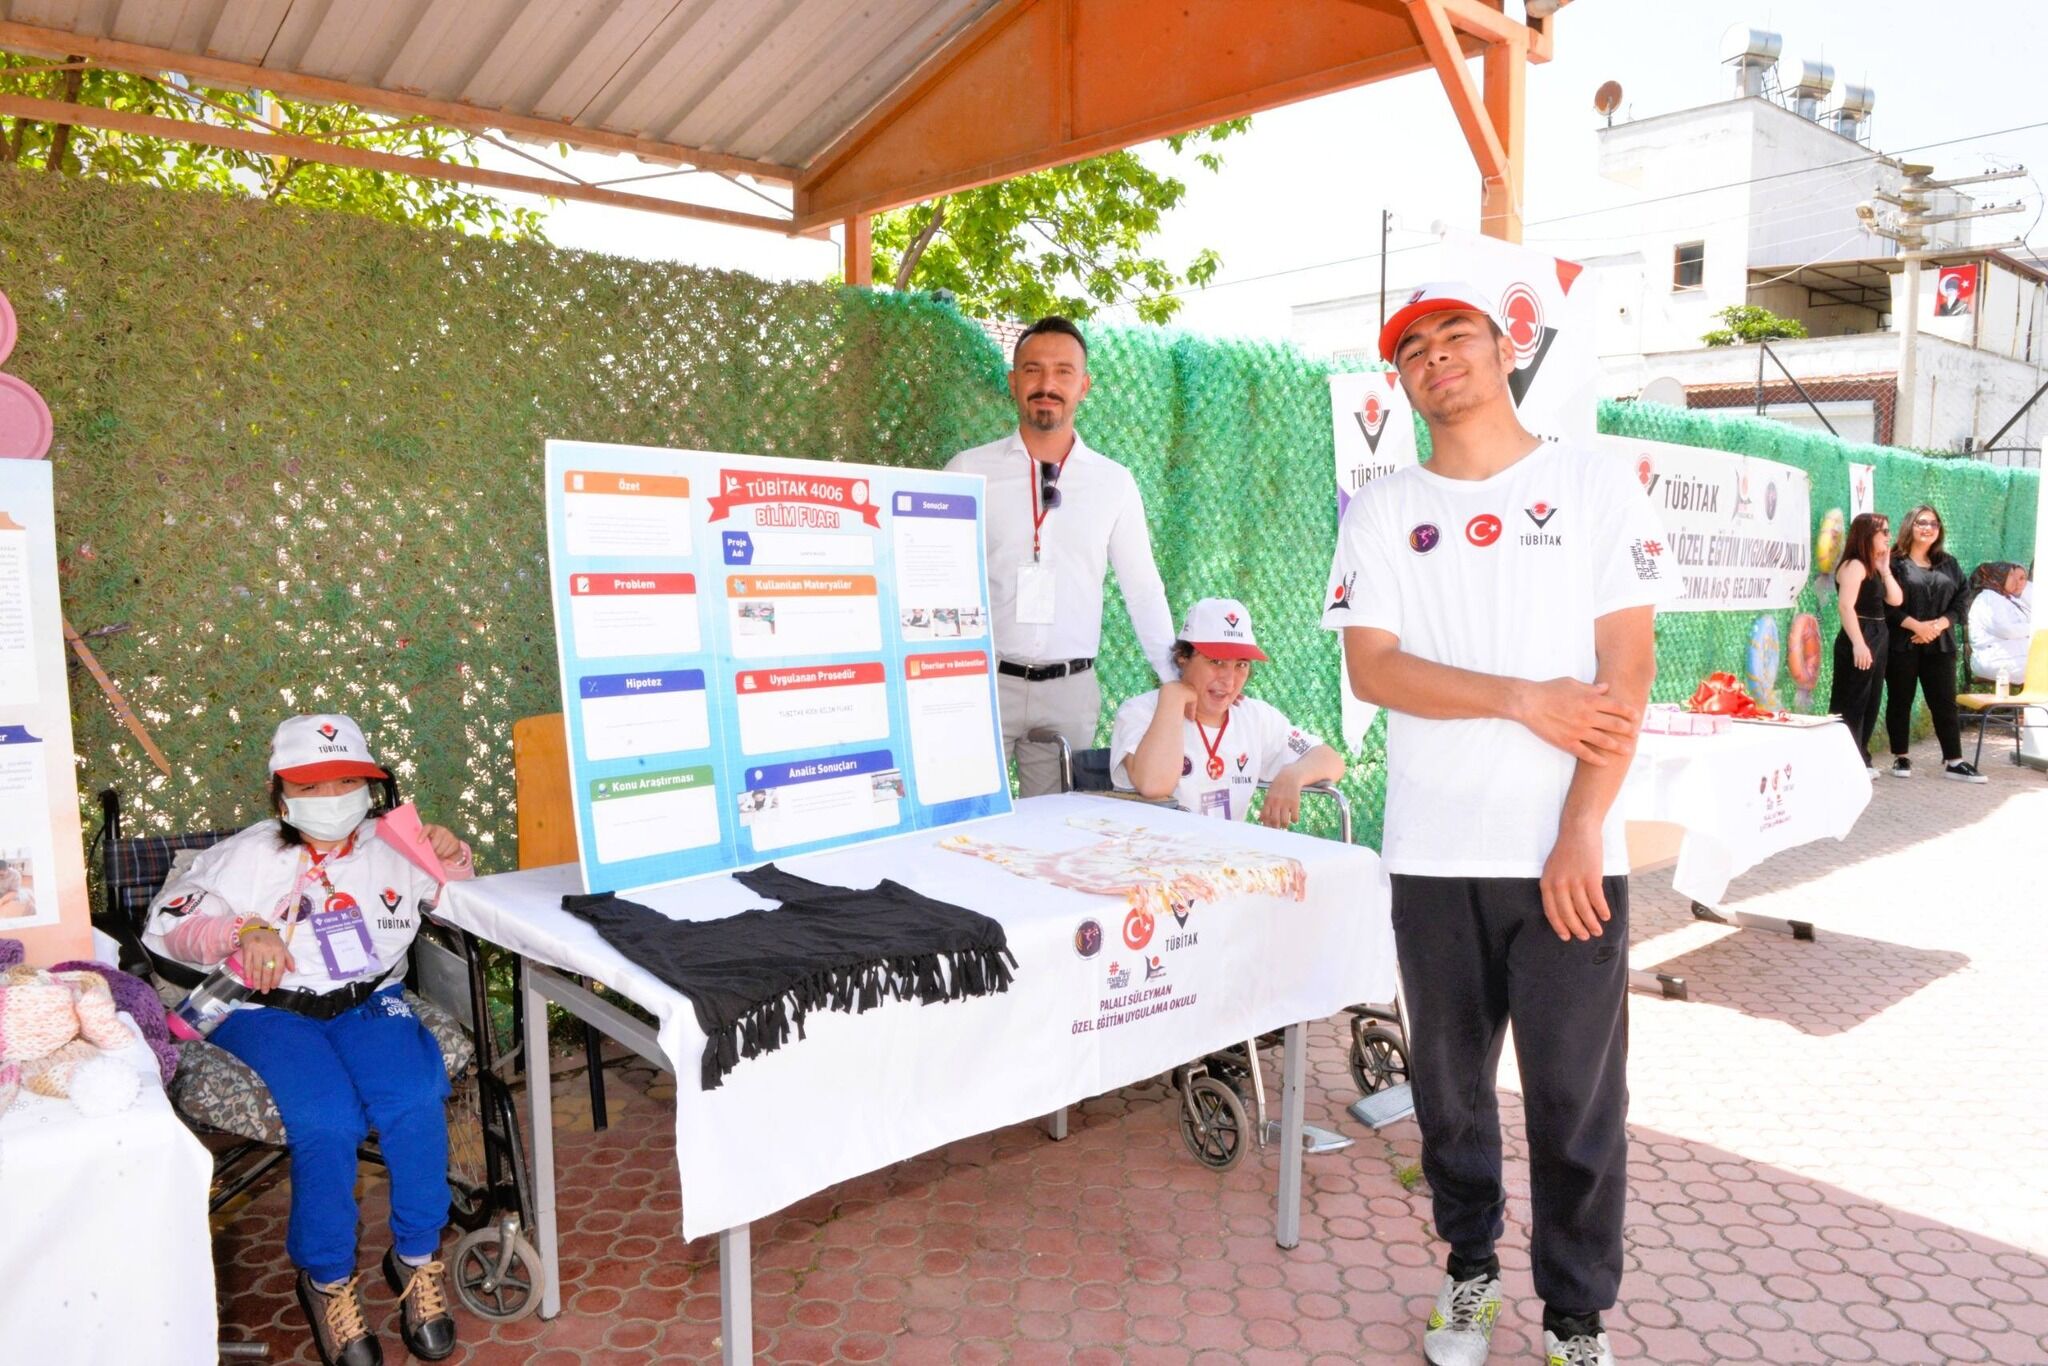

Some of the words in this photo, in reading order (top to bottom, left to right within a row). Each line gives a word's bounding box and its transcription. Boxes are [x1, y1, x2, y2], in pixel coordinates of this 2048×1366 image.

[618, 479, 641, 491] Özet
[745, 479, 807, 501] TÜBİTAK
[810, 483, 843, 501] 4006
[1664, 474, 1720, 513] TÜBİTAK
[755, 503, 797, 527] BİLİM
[799, 507, 840, 528] FUARI
[727, 538, 747, 549] Proje
[1520, 534, 1562, 546] TÜBİTAK
[1677, 526, 1704, 566] ÖZEL
[732, 549, 744, 558] Adı
[614, 579, 656, 590] Problem
[755, 580, 802, 591] Kullanılan
[803, 579, 852, 592] Materyaller
[626, 677, 662, 690] Hipotez
[769, 672, 817, 687] Uygulanan
[818, 668, 856, 682] Prosedür
[318, 744, 349, 753] TÜBİTAK
[789, 764, 816, 779] Analiz
[817, 759, 857, 776] Sonuçları
[612, 780, 638, 793] Konu
[639, 773, 694, 790] Araştırması
[377, 914, 411, 929] TÜBİTAK
[1165, 932, 1198, 952] TÜBİTAK
[1128, 984, 1172, 1006] SÜLEYMAN
[1072, 1018, 1094, 1035] ÖZEL
[1096, 1012, 1124, 1030] EĞİTİM
[1125, 1003, 1168, 1023] UYGULAMA
[1169, 993, 1197, 1010] OKULU
